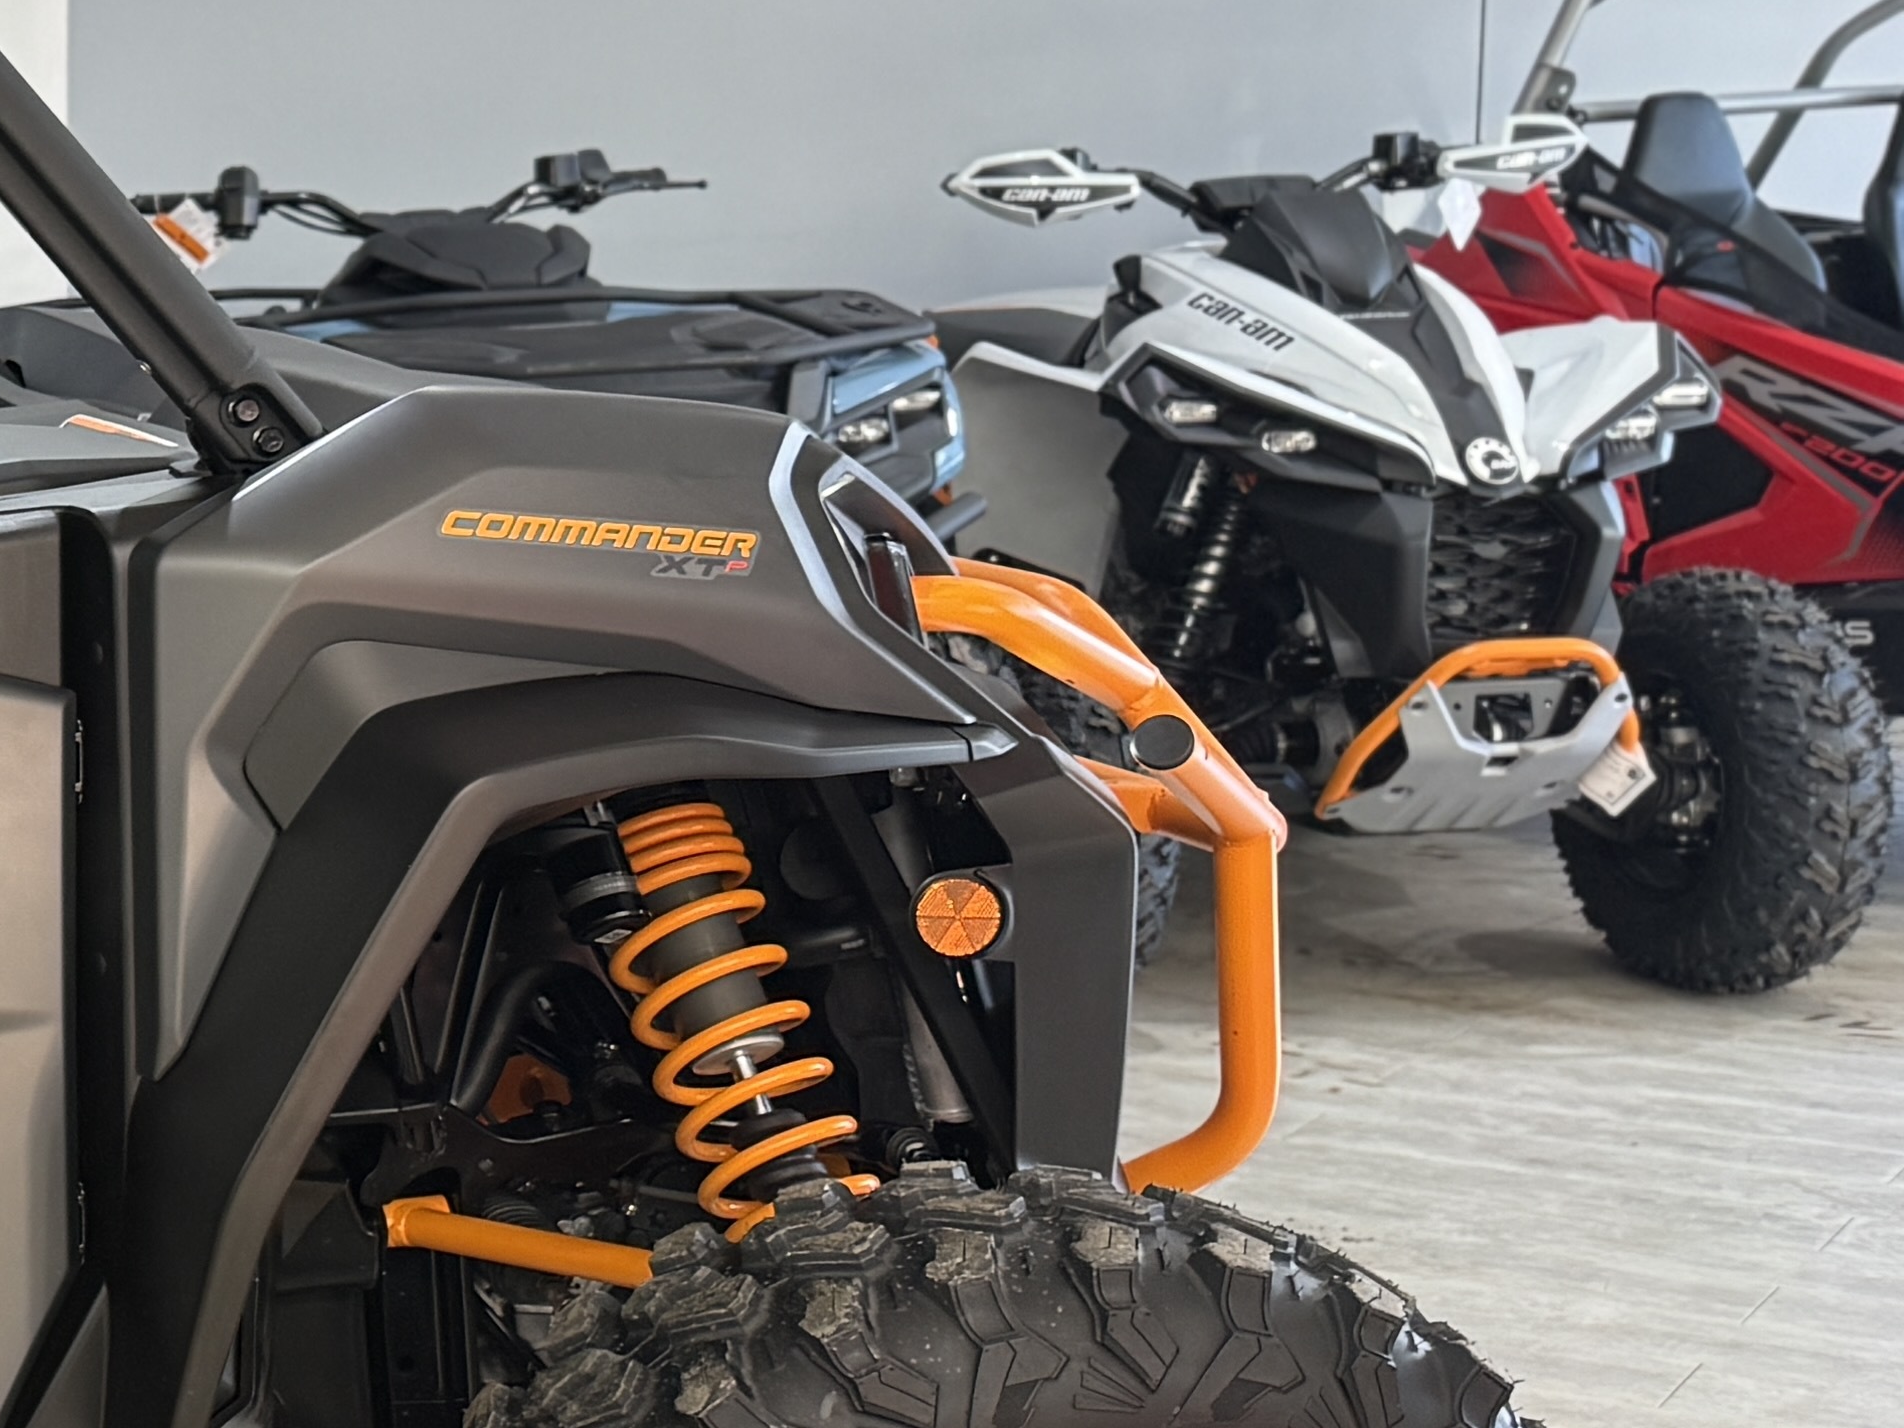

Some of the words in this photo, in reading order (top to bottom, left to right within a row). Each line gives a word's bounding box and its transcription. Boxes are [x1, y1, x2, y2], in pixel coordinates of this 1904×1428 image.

[1001, 187, 1091, 202] can-am
[1187, 291, 1295, 352] can-am
[441, 509, 758, 559] COMMANDER
